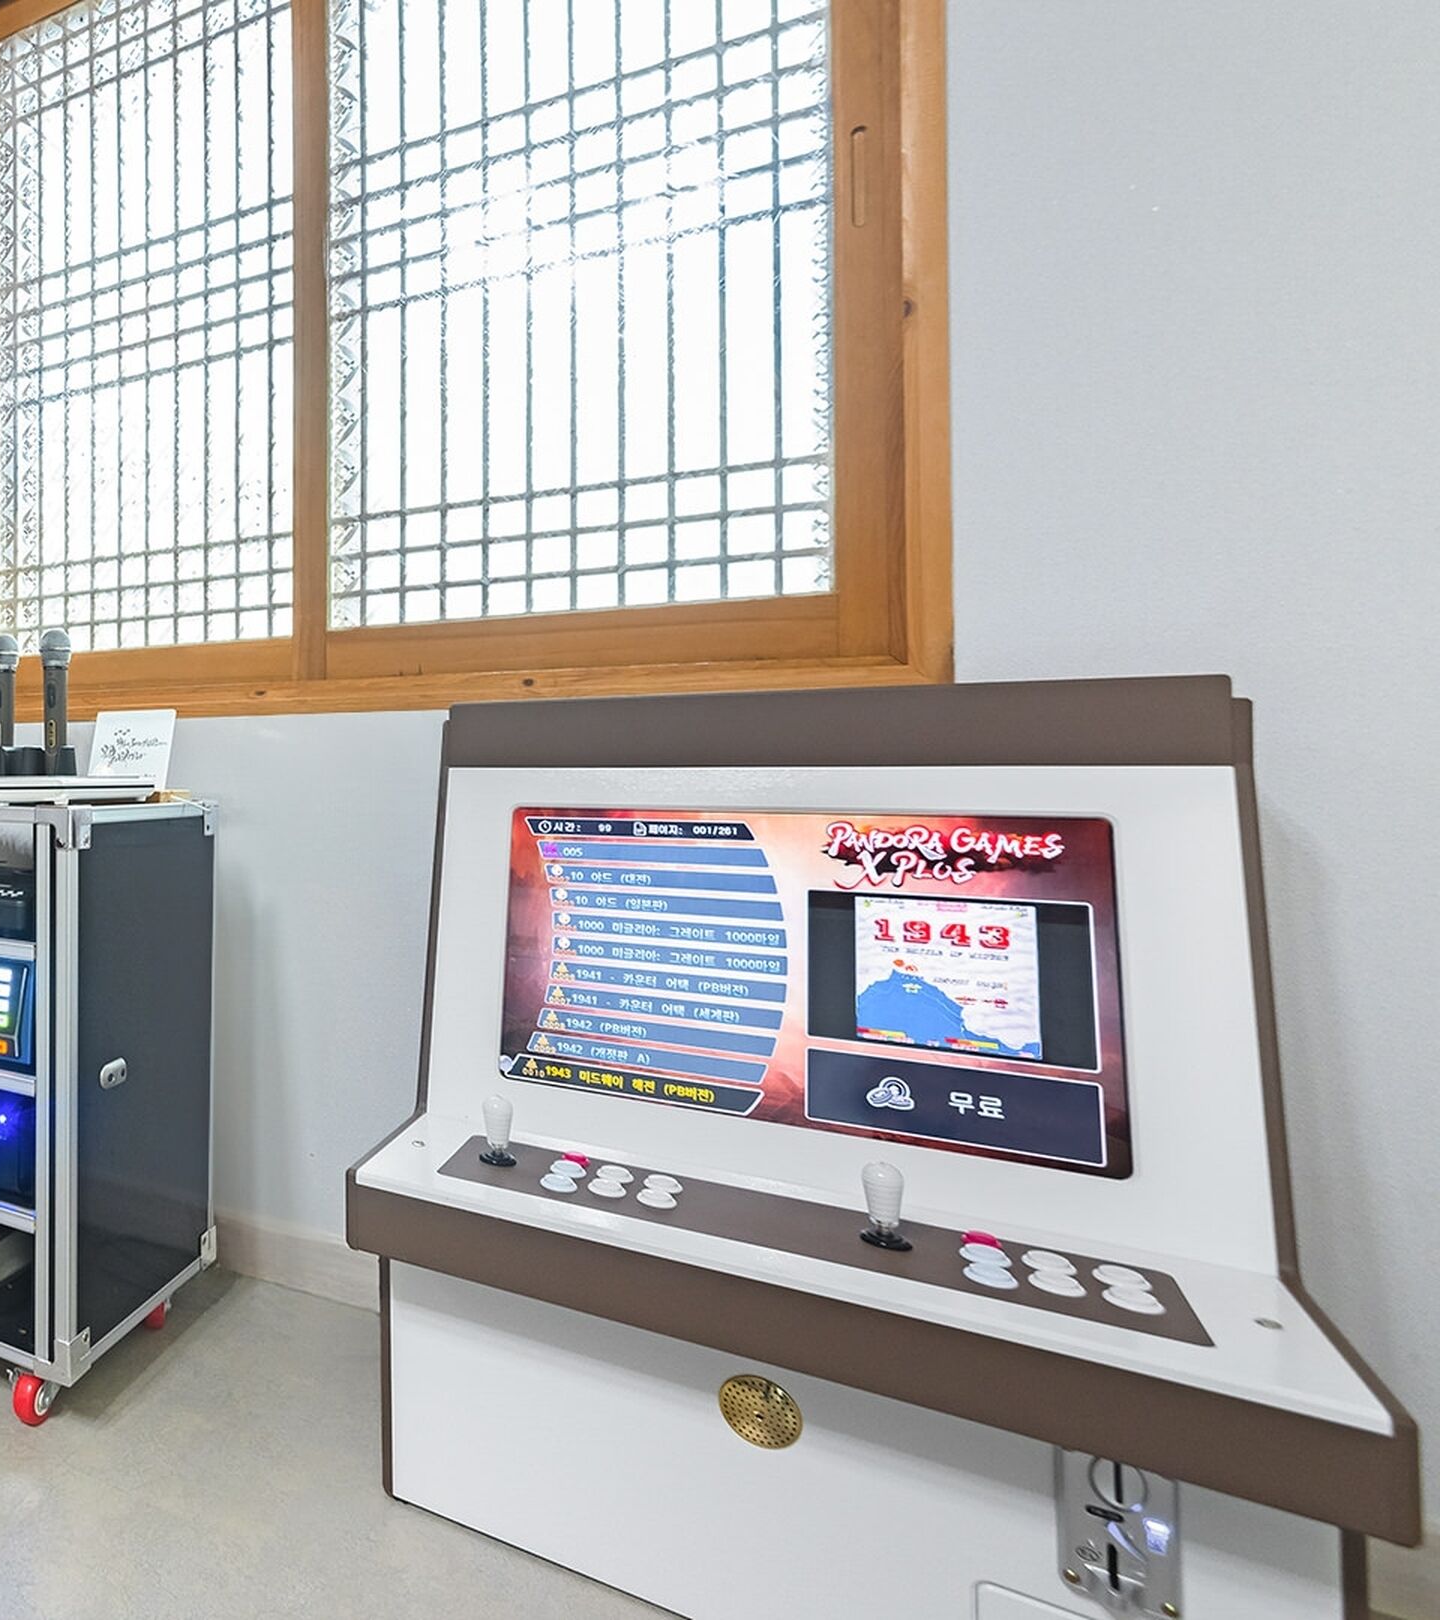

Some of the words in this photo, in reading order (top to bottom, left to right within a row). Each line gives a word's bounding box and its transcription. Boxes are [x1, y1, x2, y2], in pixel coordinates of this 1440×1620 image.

[552, 822, 582, 833] 시간:
[648, 824, 684, 836] 페이지:
[826, 822, 946, 860] PANDORA
[951, 827, 1065, 863] GAMES
[562, 847, 584, 858] 005
[570, 871, 584, 882] 10
[591, 872, 613, 883] 야드
[834, 851, 888, 889] X
[575, 895, 589, 906] 10
[596, 896, 618, 907] 야드
[578, 919, 604, 932] 1000
[874, 918, 1010, 950] 1943
[578, 944, 604, 956] 1000
[576, 968, 602, 981] 1941
[623, 973, 658, 987] 카운터
[571, 993, 598, 1005] 1941
[619, 999, 654, 1013] 카운터
[566, 1017, 593, 1030] 1942
[556, 1041, 583, 1055] 1942
[544, 1064, 572, 1079] 1943
[663, 1082, 715, 1103] (PB버전)
[948, 1091, 1006, 1120] 무료
